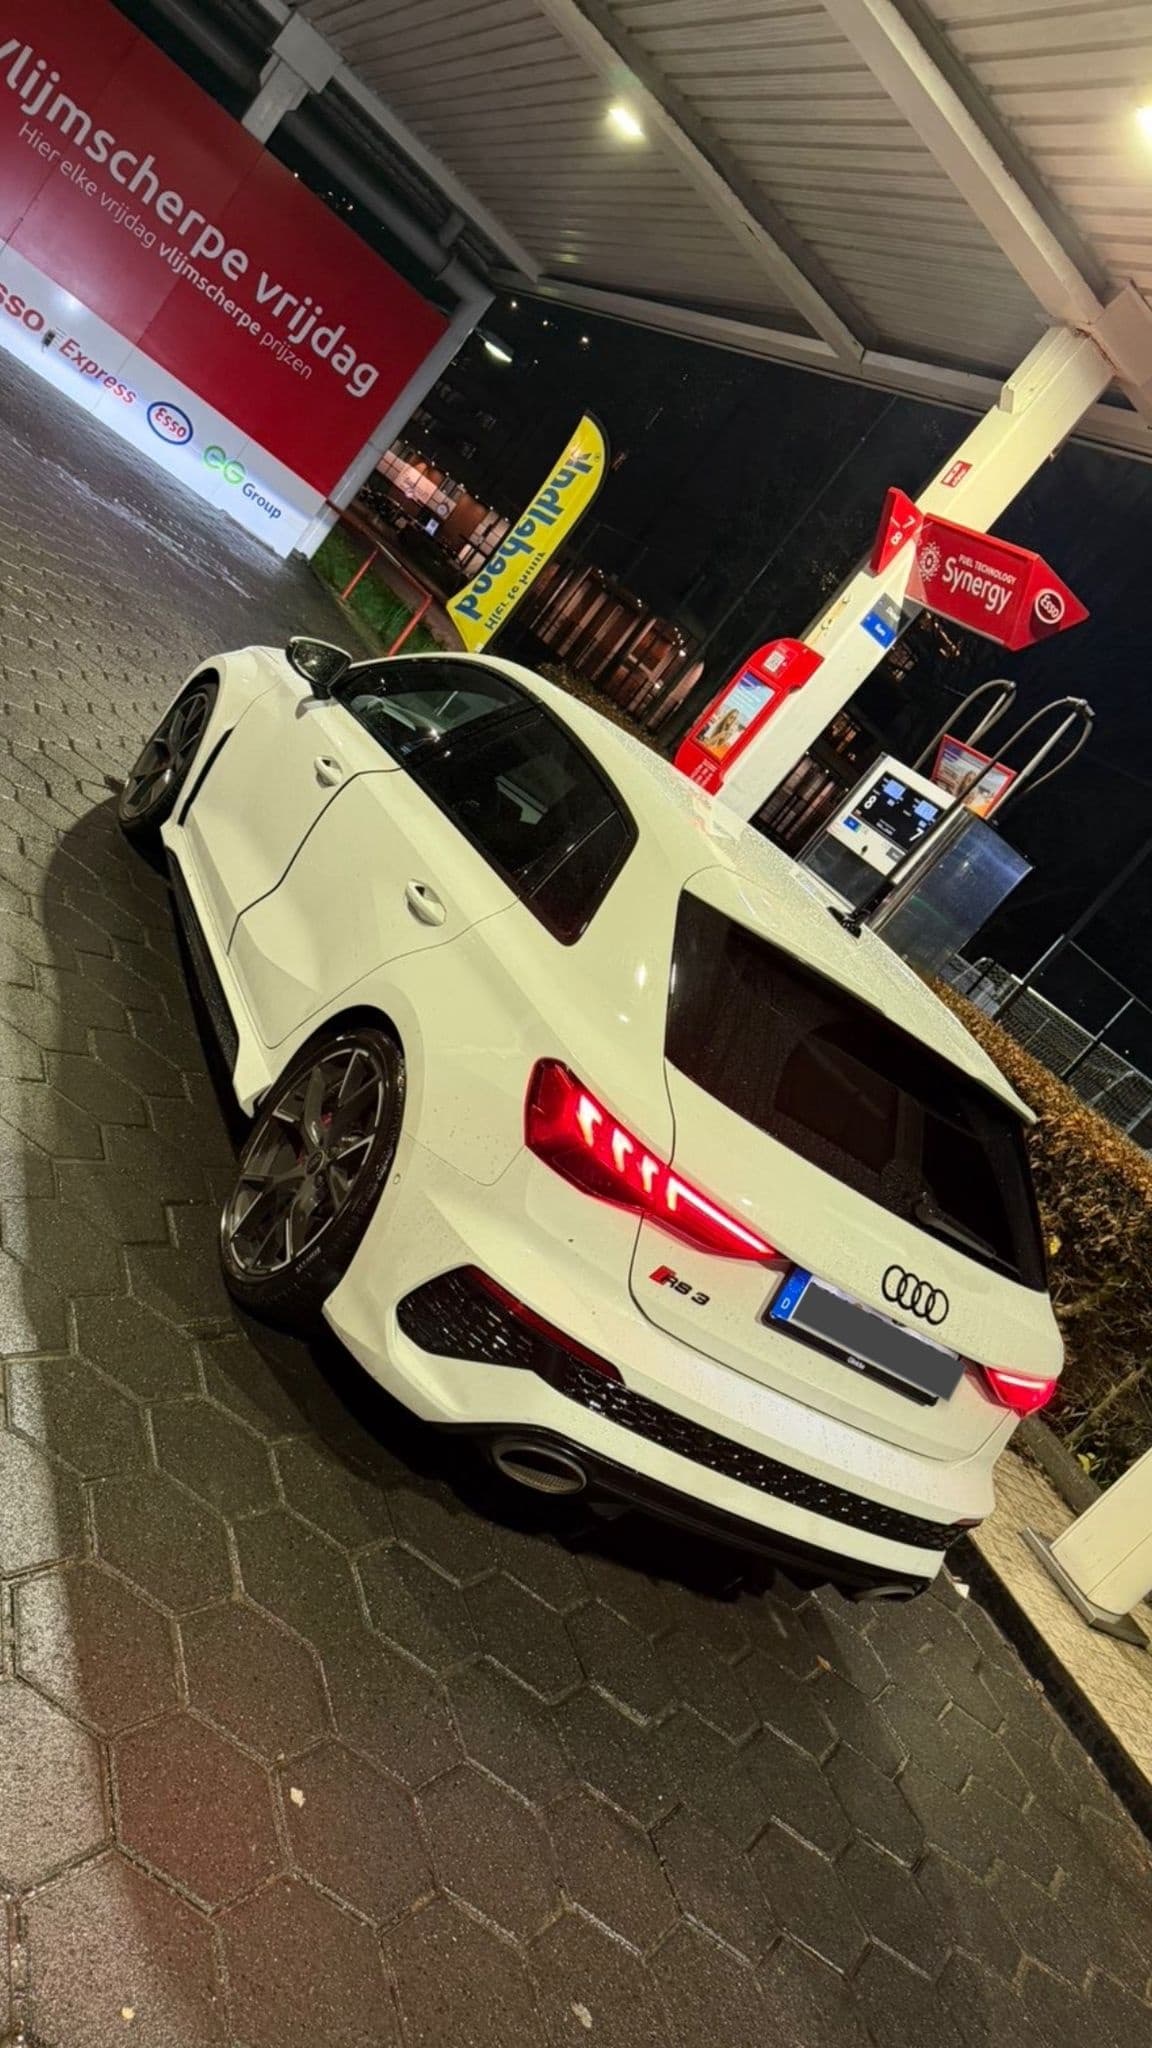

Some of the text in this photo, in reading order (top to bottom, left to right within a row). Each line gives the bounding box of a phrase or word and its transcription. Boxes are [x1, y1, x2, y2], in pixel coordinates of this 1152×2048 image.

[18, 121, 313, 380] Hier elke vrijdag vlijmscherpe prijzen
[255, 271, 380, 398] vrijdag
[59, 338, 137, 403] Express
[242, 483, 282, 519] Group
[891, 531, 903, 545] 8
[902, 515, 916, 529] 7
[942, 557, 1013, 615] Synergy
[958, 554, 1017, 586] FUEL TECHNOLOGY
[864, 795, 877, 809] 8
[909, 827, 924, 842] 7
[656, 1269, 710, 1306] RS 3
[781, 1298, 791, 1310] D
